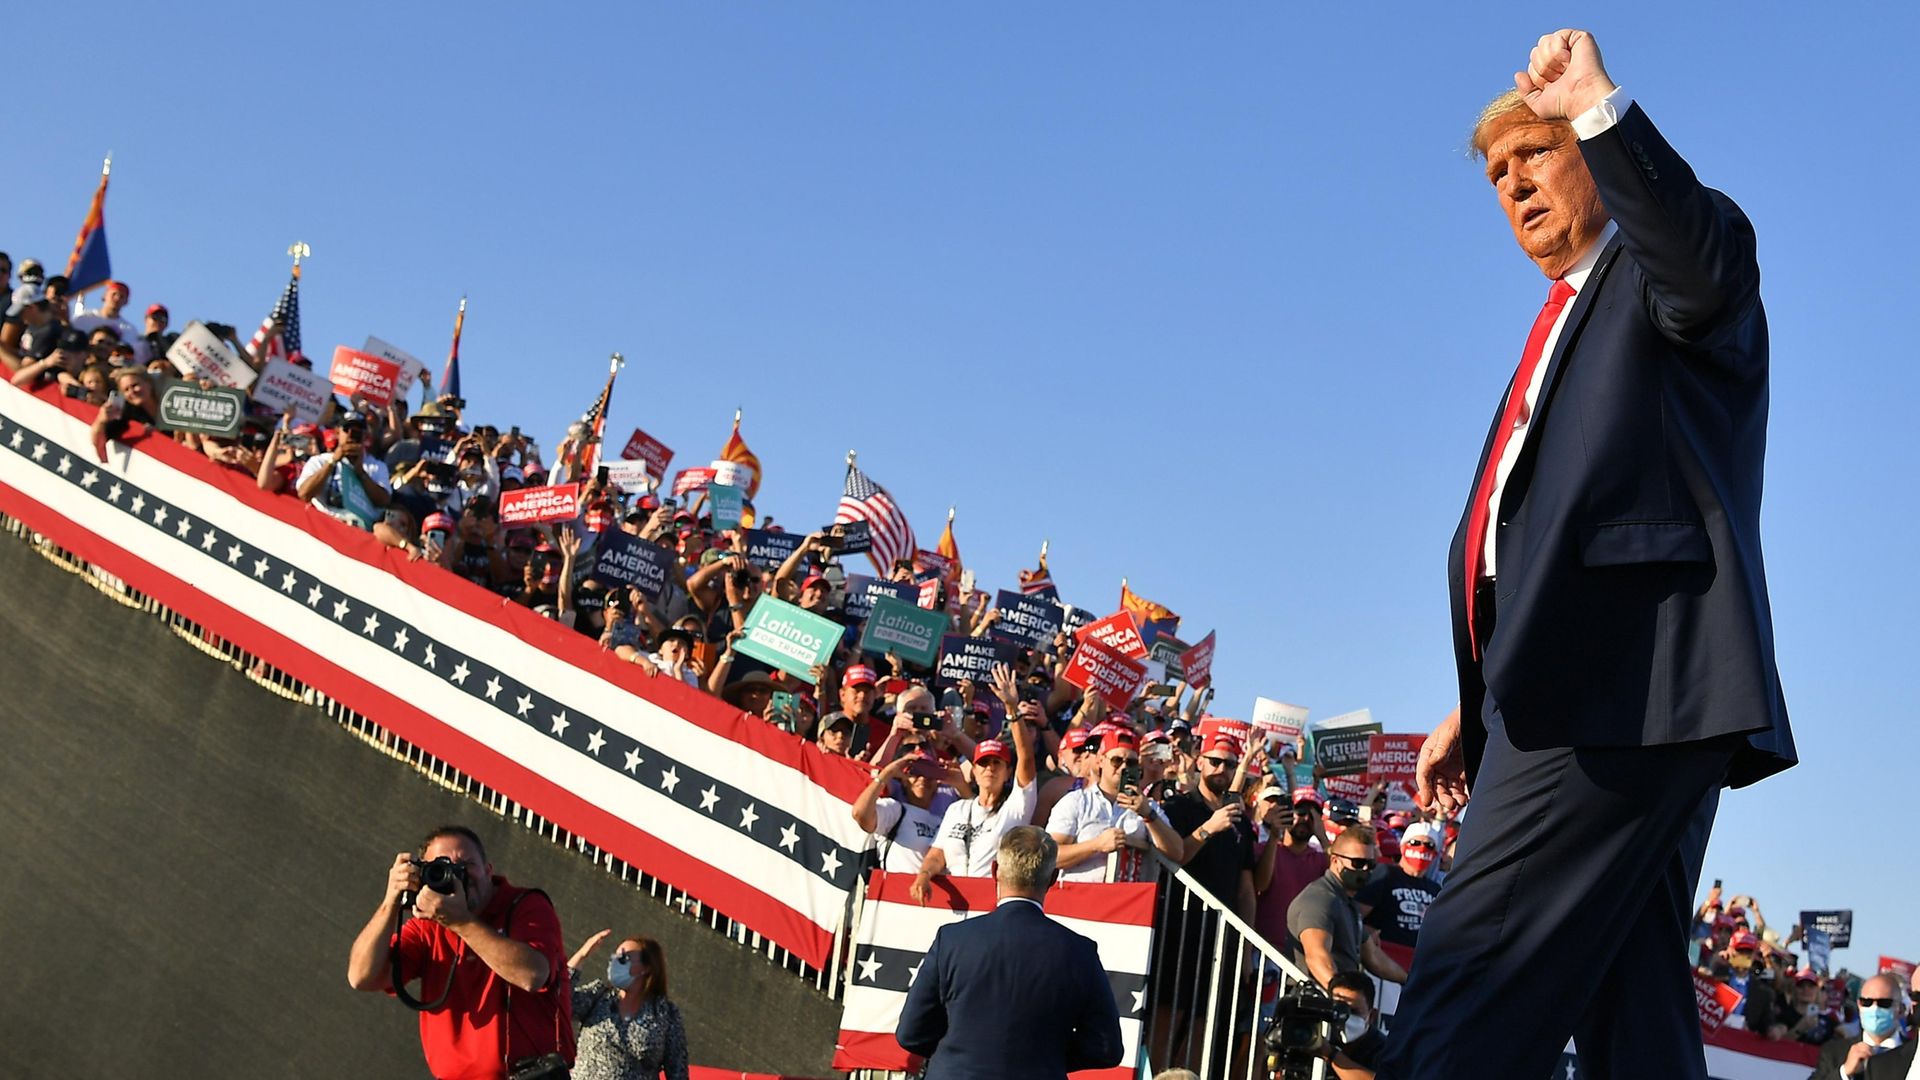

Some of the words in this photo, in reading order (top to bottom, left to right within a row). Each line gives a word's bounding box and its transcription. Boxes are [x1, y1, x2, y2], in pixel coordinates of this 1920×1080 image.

[352, 357, 380, 373] MAKE
[288, 371, 313, 387] MAKE
[333, 362, 392, 391] AMERICA
[261, 384, 292, 402] GREAT
[265, 375, 324, 405] AMERICA
[357, 383, 391, 399] AGAIN
[172, 395, 235, 416] VETERANS
[630, 441, 669, 468] AMERICA
[503, 494, 575, 514] AMERICA
[525, 489, 556, 501] MAKE
[504, 510, 538, 522] GREAT
[539, 504, 575, 518] AGAIN
[767, 537, 794, 549] MAKE
[627, 543, 656, 562] MAKE
[602, 549, 665, 583] AMERICA
[597, 562, 633, 582] GREAT
[634, 575, 661, 593] AGAIN
[867, 584, 898, 600] MAKE
[1018, 601, 1047, 617] MAKE
[878, 610, 934, 639] Latinos
[994, 622, 1028, 637] GREAT
[1000, 607, 1060, 635] AMERICA
[757, 610, 823, 655] Latinos
[874, 628, 894, 642] FOR
[896, 633, 927, 649] TRUMP
[1102, 628, 1137, 648] RICA
[752, 630, 777, 648] FOR
[776, 640, 814, 662] TRUMP
[964, 644, 995, 657] MAKE
[1081, 642, 1113, 665] AGAIN
[941, 668, 977, 682] GREAT
[1076, 653, 1134, 692] AMERICA
[1110, 660, 1140, 682] GREAT
[1263, 711, 1303, 728] atinos
[1217, 726, 1248, 743] MAKE
[1324, 741, 1369, 758] VETERAN
[1384, 741, 1409, 750] MAKE
[1371, 765, 1395, 774] GREAT
[1391, 887, 1432, 904] TRUM
[1695, 990, 1725, 1020] RICA
